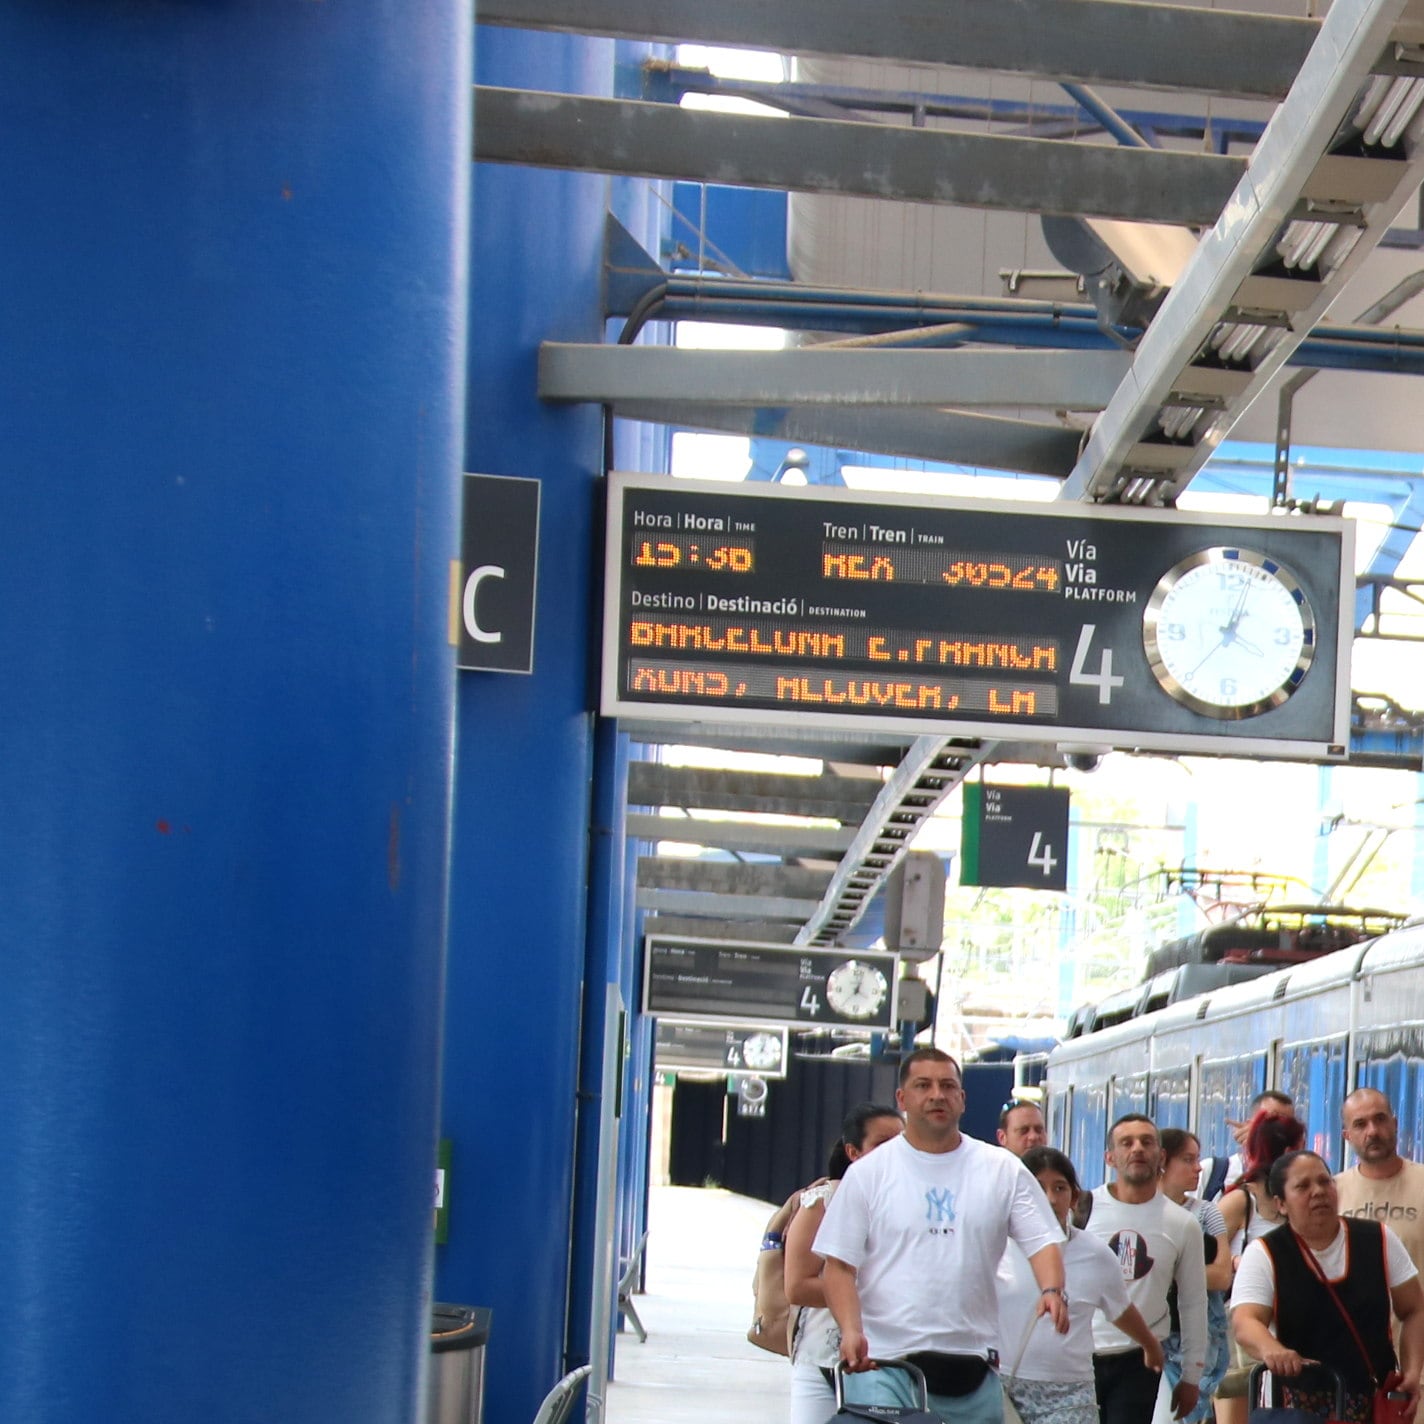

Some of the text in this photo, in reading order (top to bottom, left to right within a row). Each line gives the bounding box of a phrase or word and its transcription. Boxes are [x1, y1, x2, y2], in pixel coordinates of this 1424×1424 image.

[633, 510, 756, 532] Hora Hora TIME
[823, 522, 944, 545] Tren Tren TRAIN
[1066, 538, 1098, 561] Vía
[1065, 563, 1097, 584] Via
[463, 565, 505, 643] C
[631, 590, 866, 618] Destino Destinació DESTINATION
[1064, 585, 1137, 603] PLATFORM
[1069, 623, 1125, 705] 4
[985, 802, 1001, 813] Via
[1026, 831, 1058, 875] 4
[800, 986, 821, 1017] 4
[727, 1047, 741, 1068] 4
